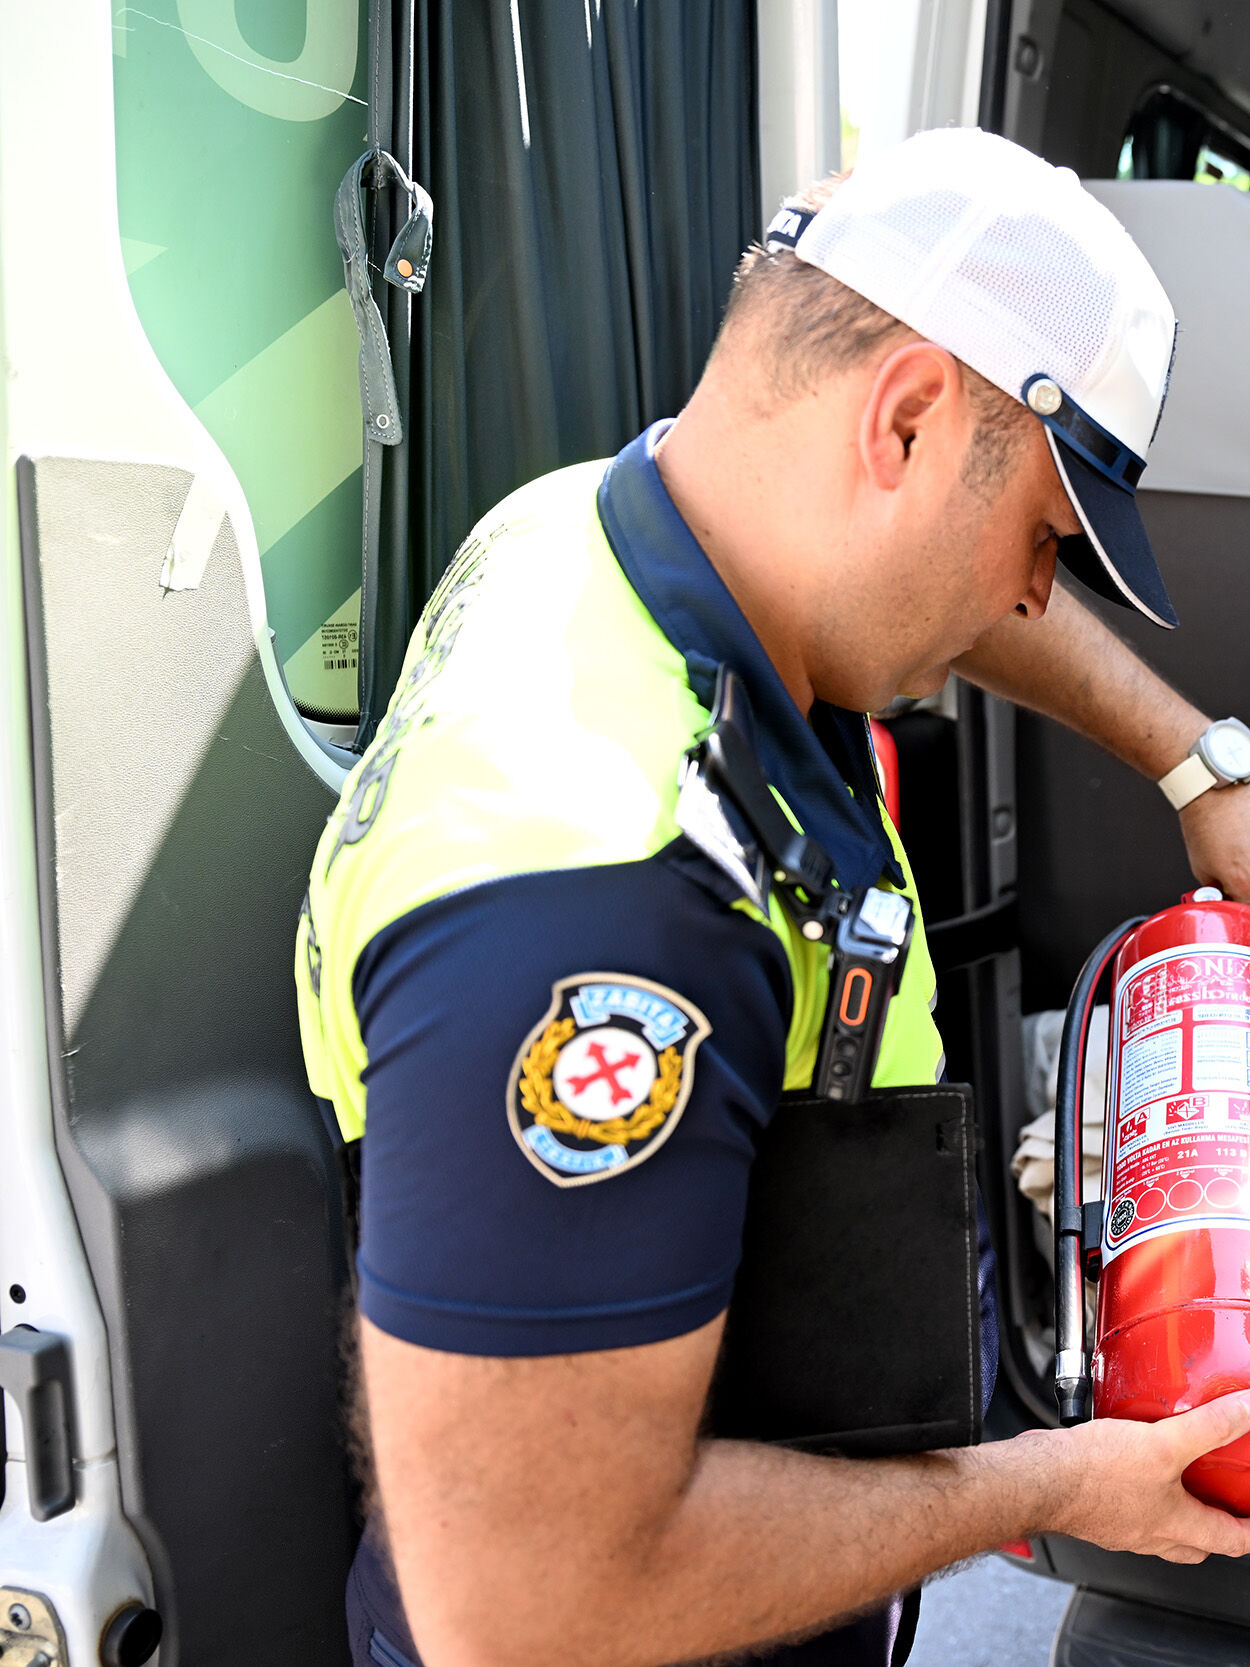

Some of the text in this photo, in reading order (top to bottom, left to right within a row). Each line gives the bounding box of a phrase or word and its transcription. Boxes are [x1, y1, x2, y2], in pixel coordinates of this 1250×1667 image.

[1192, 1096, 1206, 1107] B
[1136, 1111, 1148, 1123] A
[1142, 1143, 1161, 1157] KADAR
[1161, 1141, 1171, 1150] EN
[1171, 1138, 1180, 1147] AZ
[1180, 1134, 1216, 1145] KULLANMA
[1177, 1149, 1199, 1160] 21A
[1215, 1147, 1237, 1157] 113
